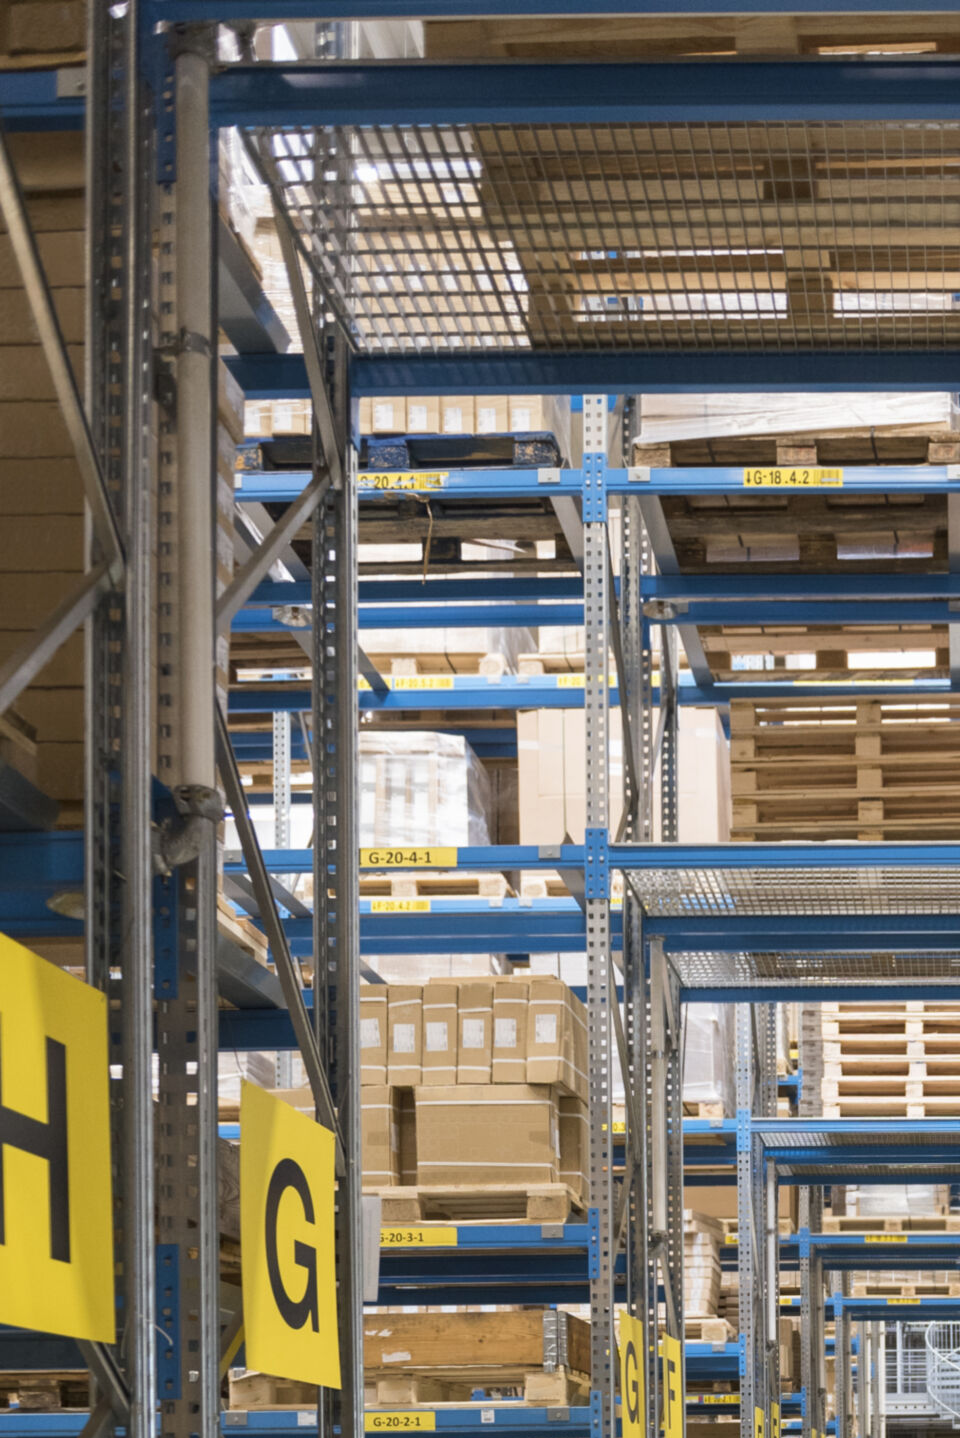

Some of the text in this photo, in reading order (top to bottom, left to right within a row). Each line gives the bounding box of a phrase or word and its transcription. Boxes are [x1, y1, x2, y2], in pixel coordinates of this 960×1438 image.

[754, 470, 809, 485] G-18.4.2
[368, 851, 432, 864] G-20-4-1
[0, 1010, 71, 1264] H
[264, 1157, 320, 1334] G
[625, 1340, 640, 1424] G
[667, 1359, 676, 1430] F
[373, 1416, 421, 1427] G-20-2-1
